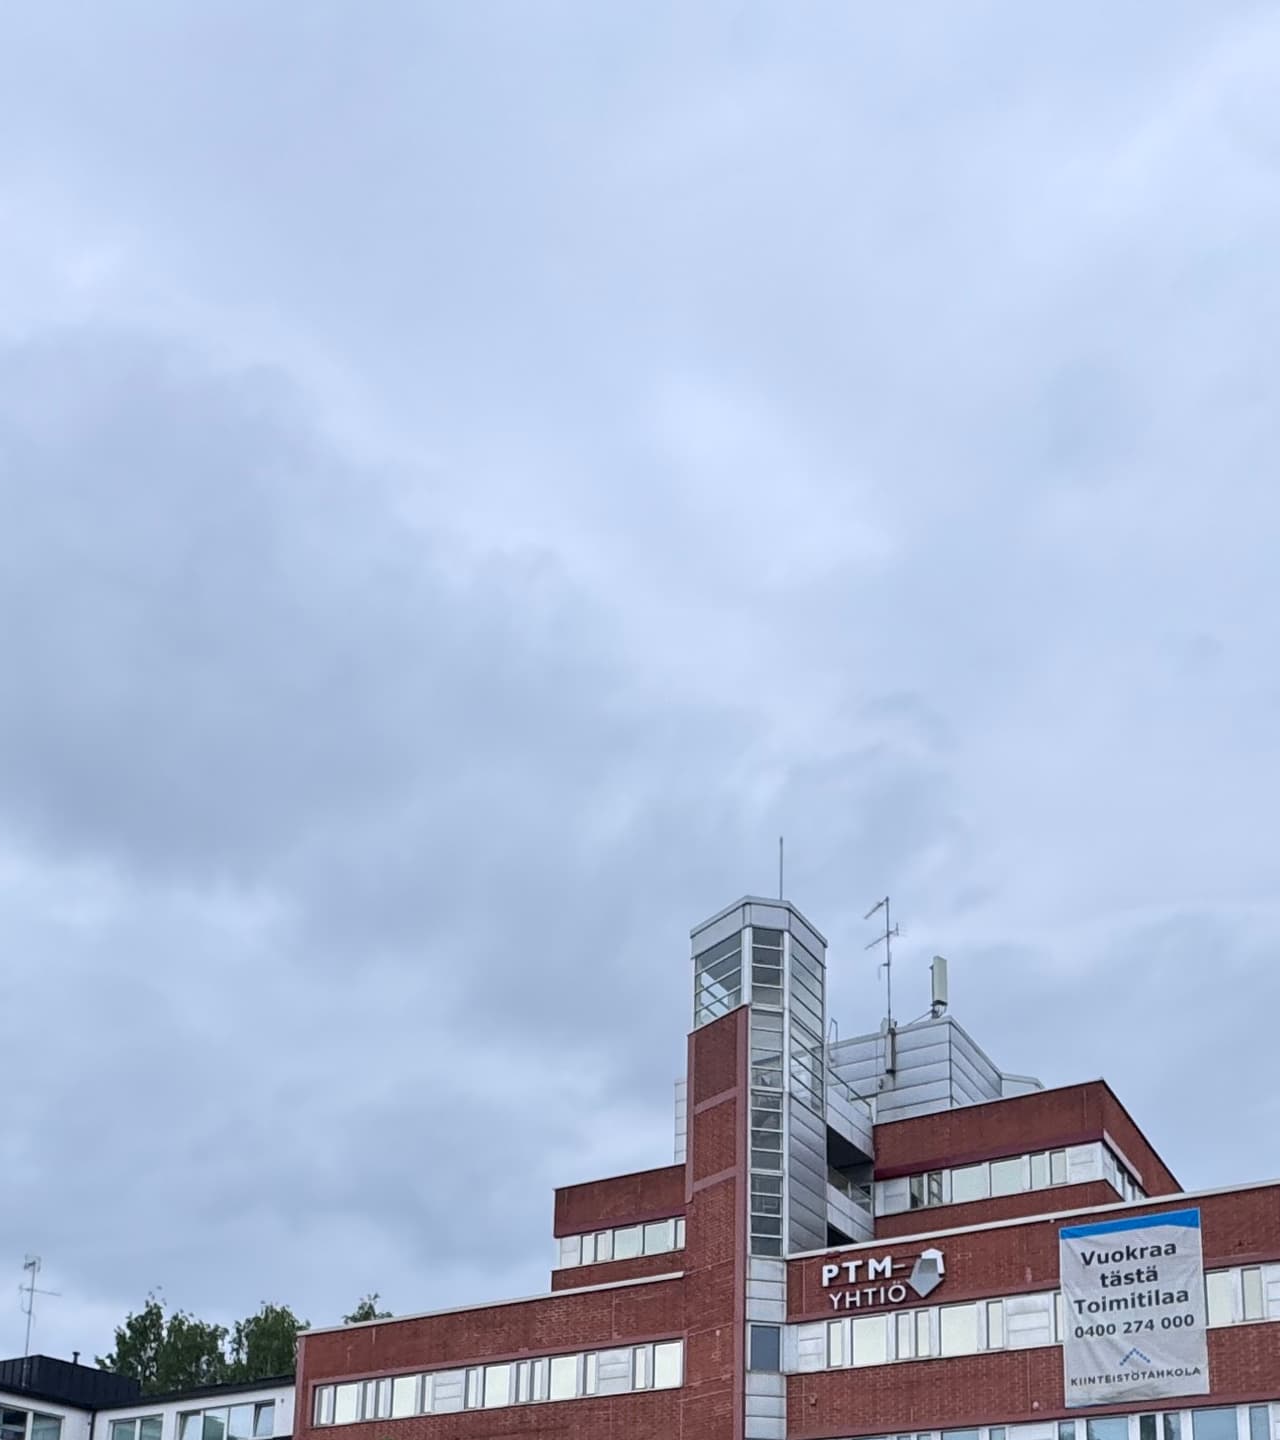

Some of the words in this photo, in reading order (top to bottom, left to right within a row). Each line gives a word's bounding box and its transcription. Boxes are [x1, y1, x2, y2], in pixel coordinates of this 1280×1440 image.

[1081, 1242, 1177, 1266] Vuokraa
[1100, 1265, 1159, 1288] tästä
[829, 1280, 906, 1310] YHTIÖ
[1073, 1289, 1189, 1315] Toimitilaa
[1074, 1323, 1116, 1338] 0400
[1122, 1318, 1155, 1334] 274
[1161, 1314, 1195, 1330] 000
[1071, 1366, 1201, 1387] KIINTEISTÖTAHKOLA
